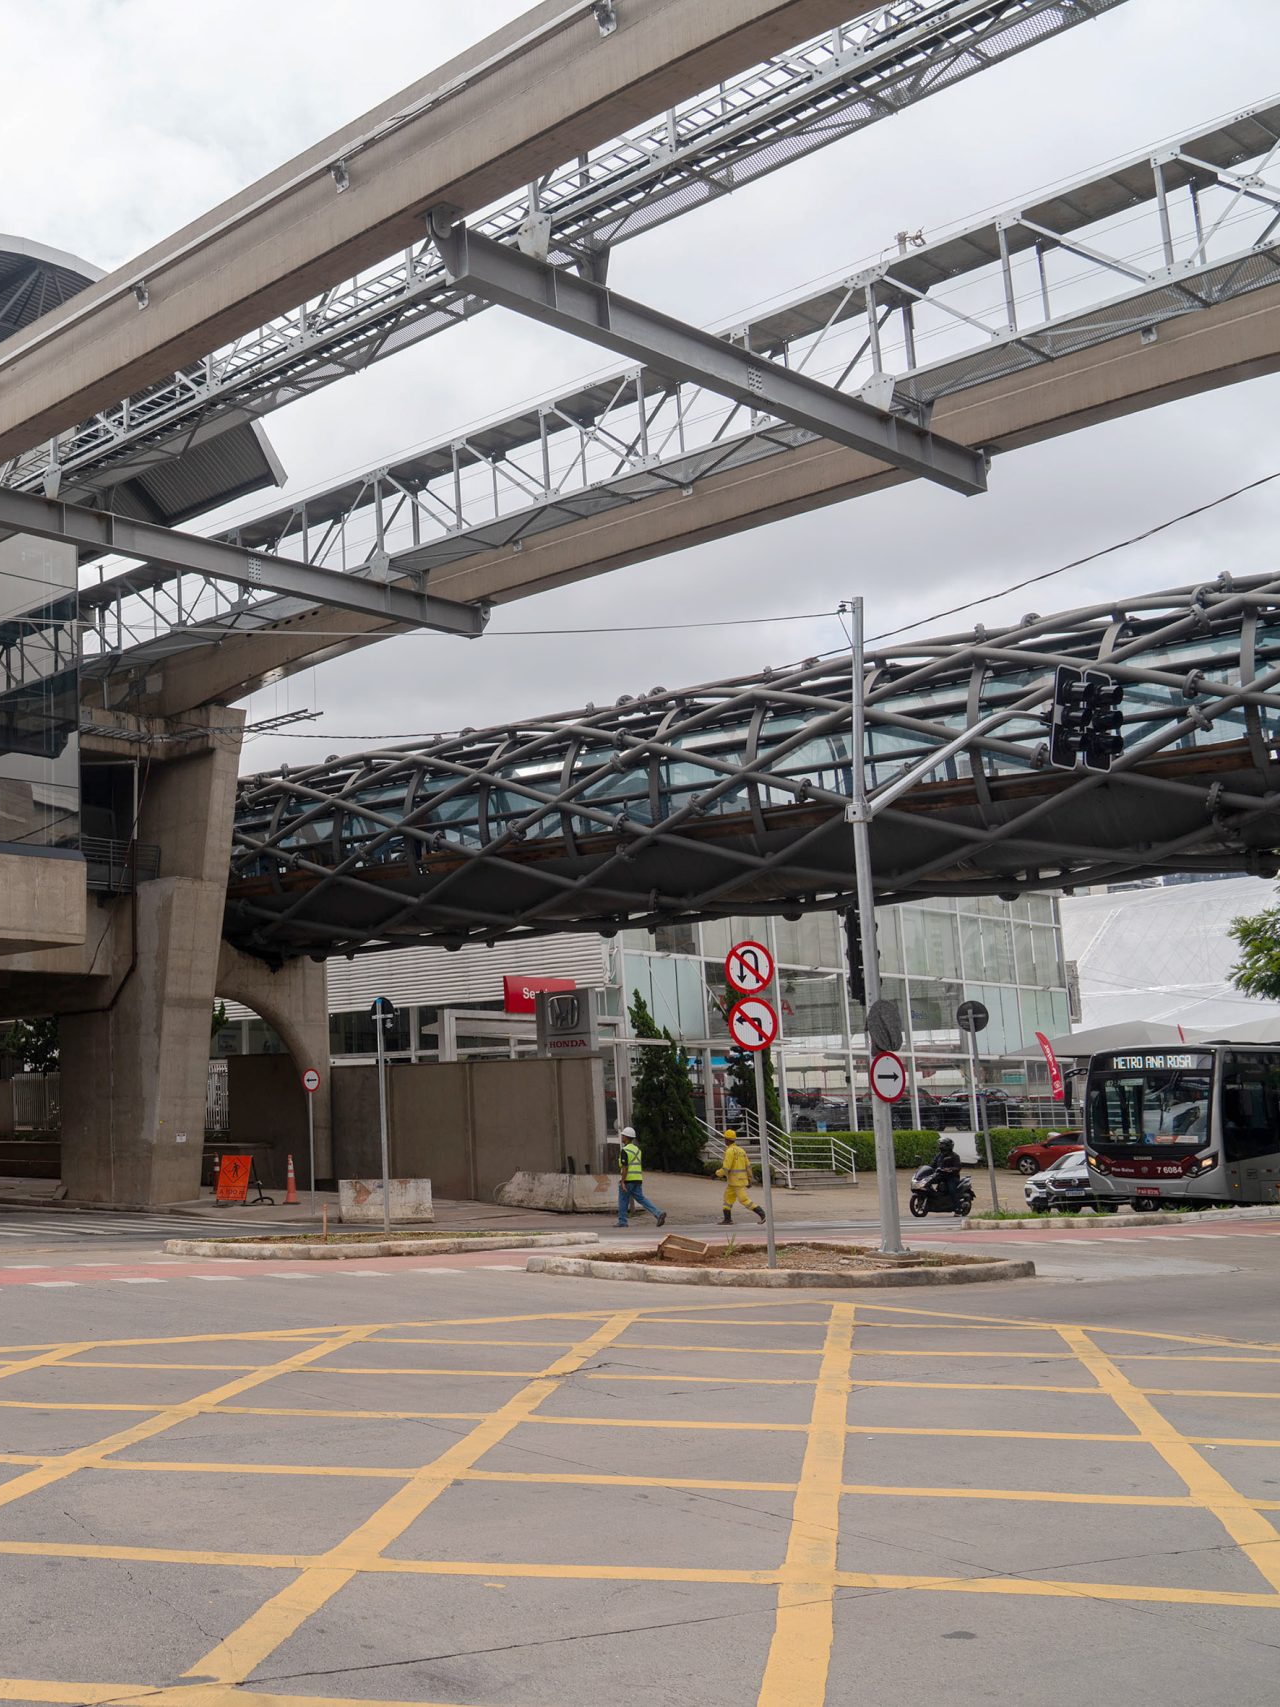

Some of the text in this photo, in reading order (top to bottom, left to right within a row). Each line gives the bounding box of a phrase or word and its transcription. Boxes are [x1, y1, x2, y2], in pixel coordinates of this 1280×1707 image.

[549, 1040, 587, 1048] HONDA
[1113, 1055, 1192, 1069] METRO ANA ROSA
[1163, 1166, 1183, 1174] 6084
